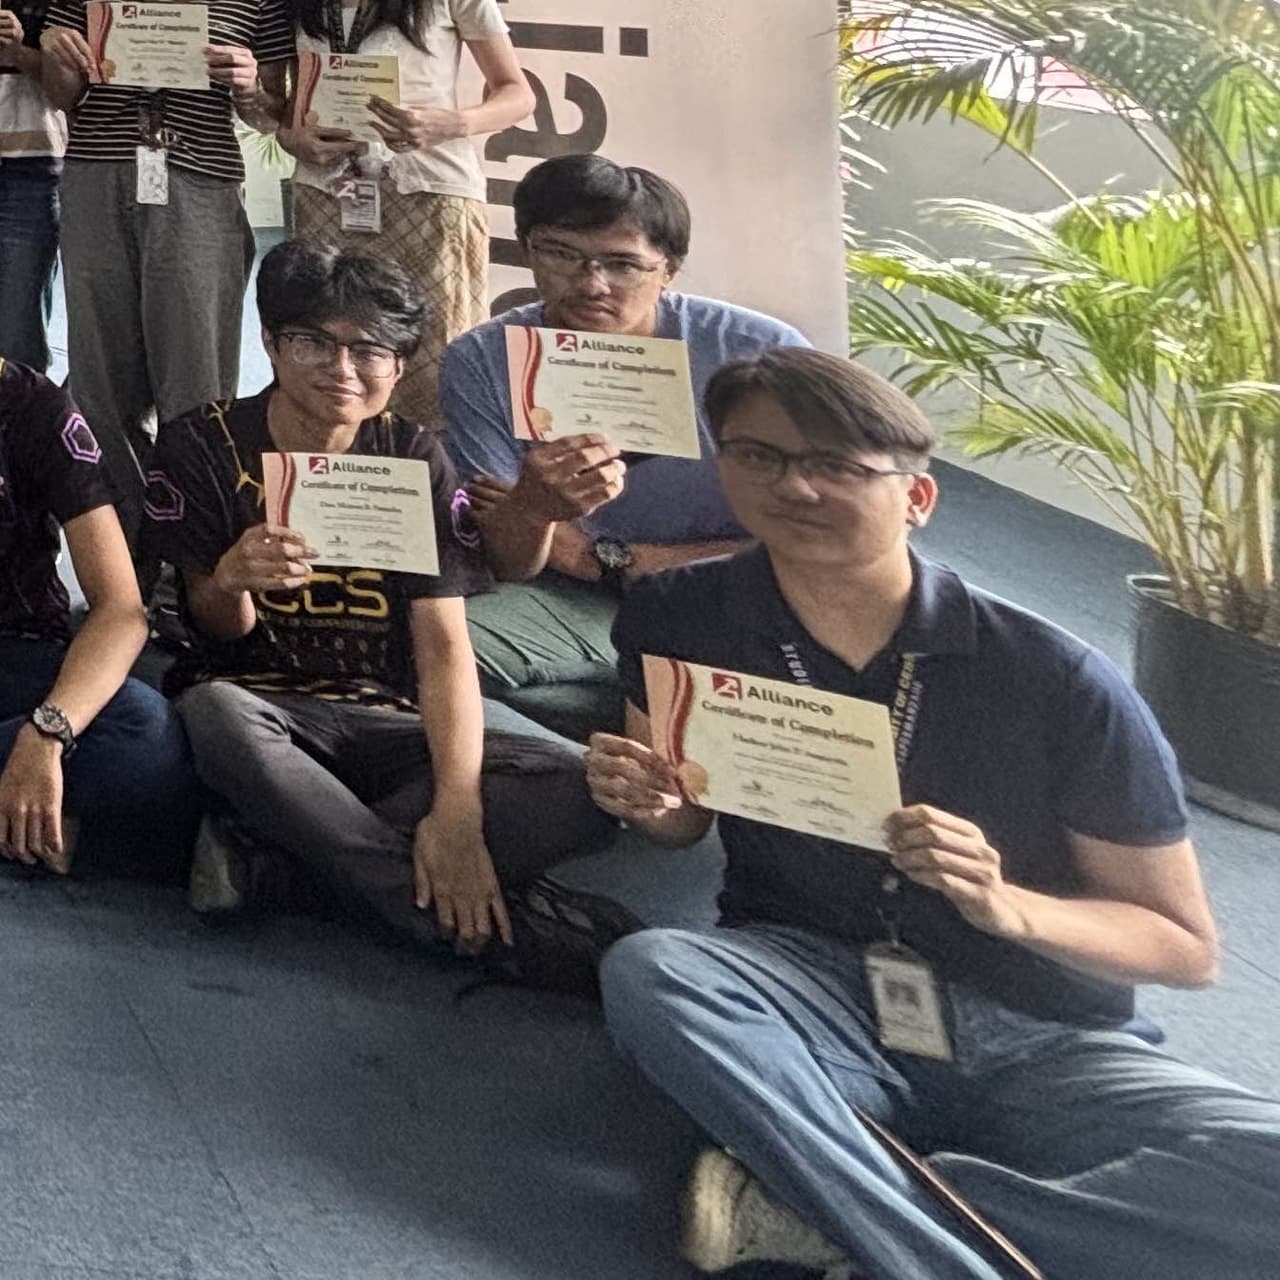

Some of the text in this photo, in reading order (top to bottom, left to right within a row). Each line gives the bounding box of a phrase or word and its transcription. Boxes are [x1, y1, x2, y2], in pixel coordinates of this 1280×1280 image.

[581, 340, 646, 355] Alliance
[332, 462, 391, 476] Alliance
[747, 686, 834, 716] Alliance
